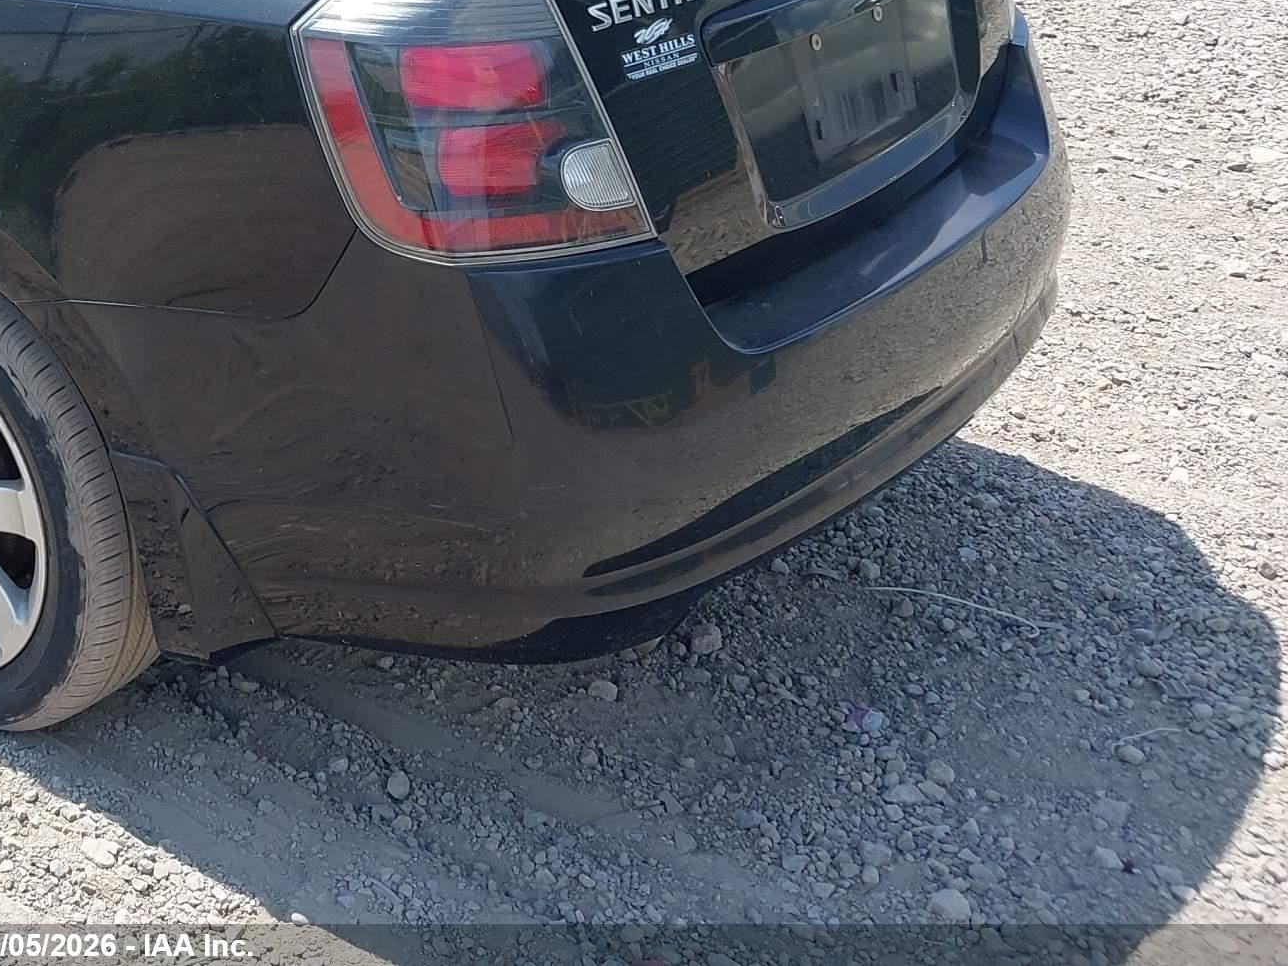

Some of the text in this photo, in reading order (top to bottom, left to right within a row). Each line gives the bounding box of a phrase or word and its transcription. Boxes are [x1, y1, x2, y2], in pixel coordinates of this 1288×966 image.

[621, 34, 695, 65] WEST HILLS
[643, 52, 680, 68] NISSAN
